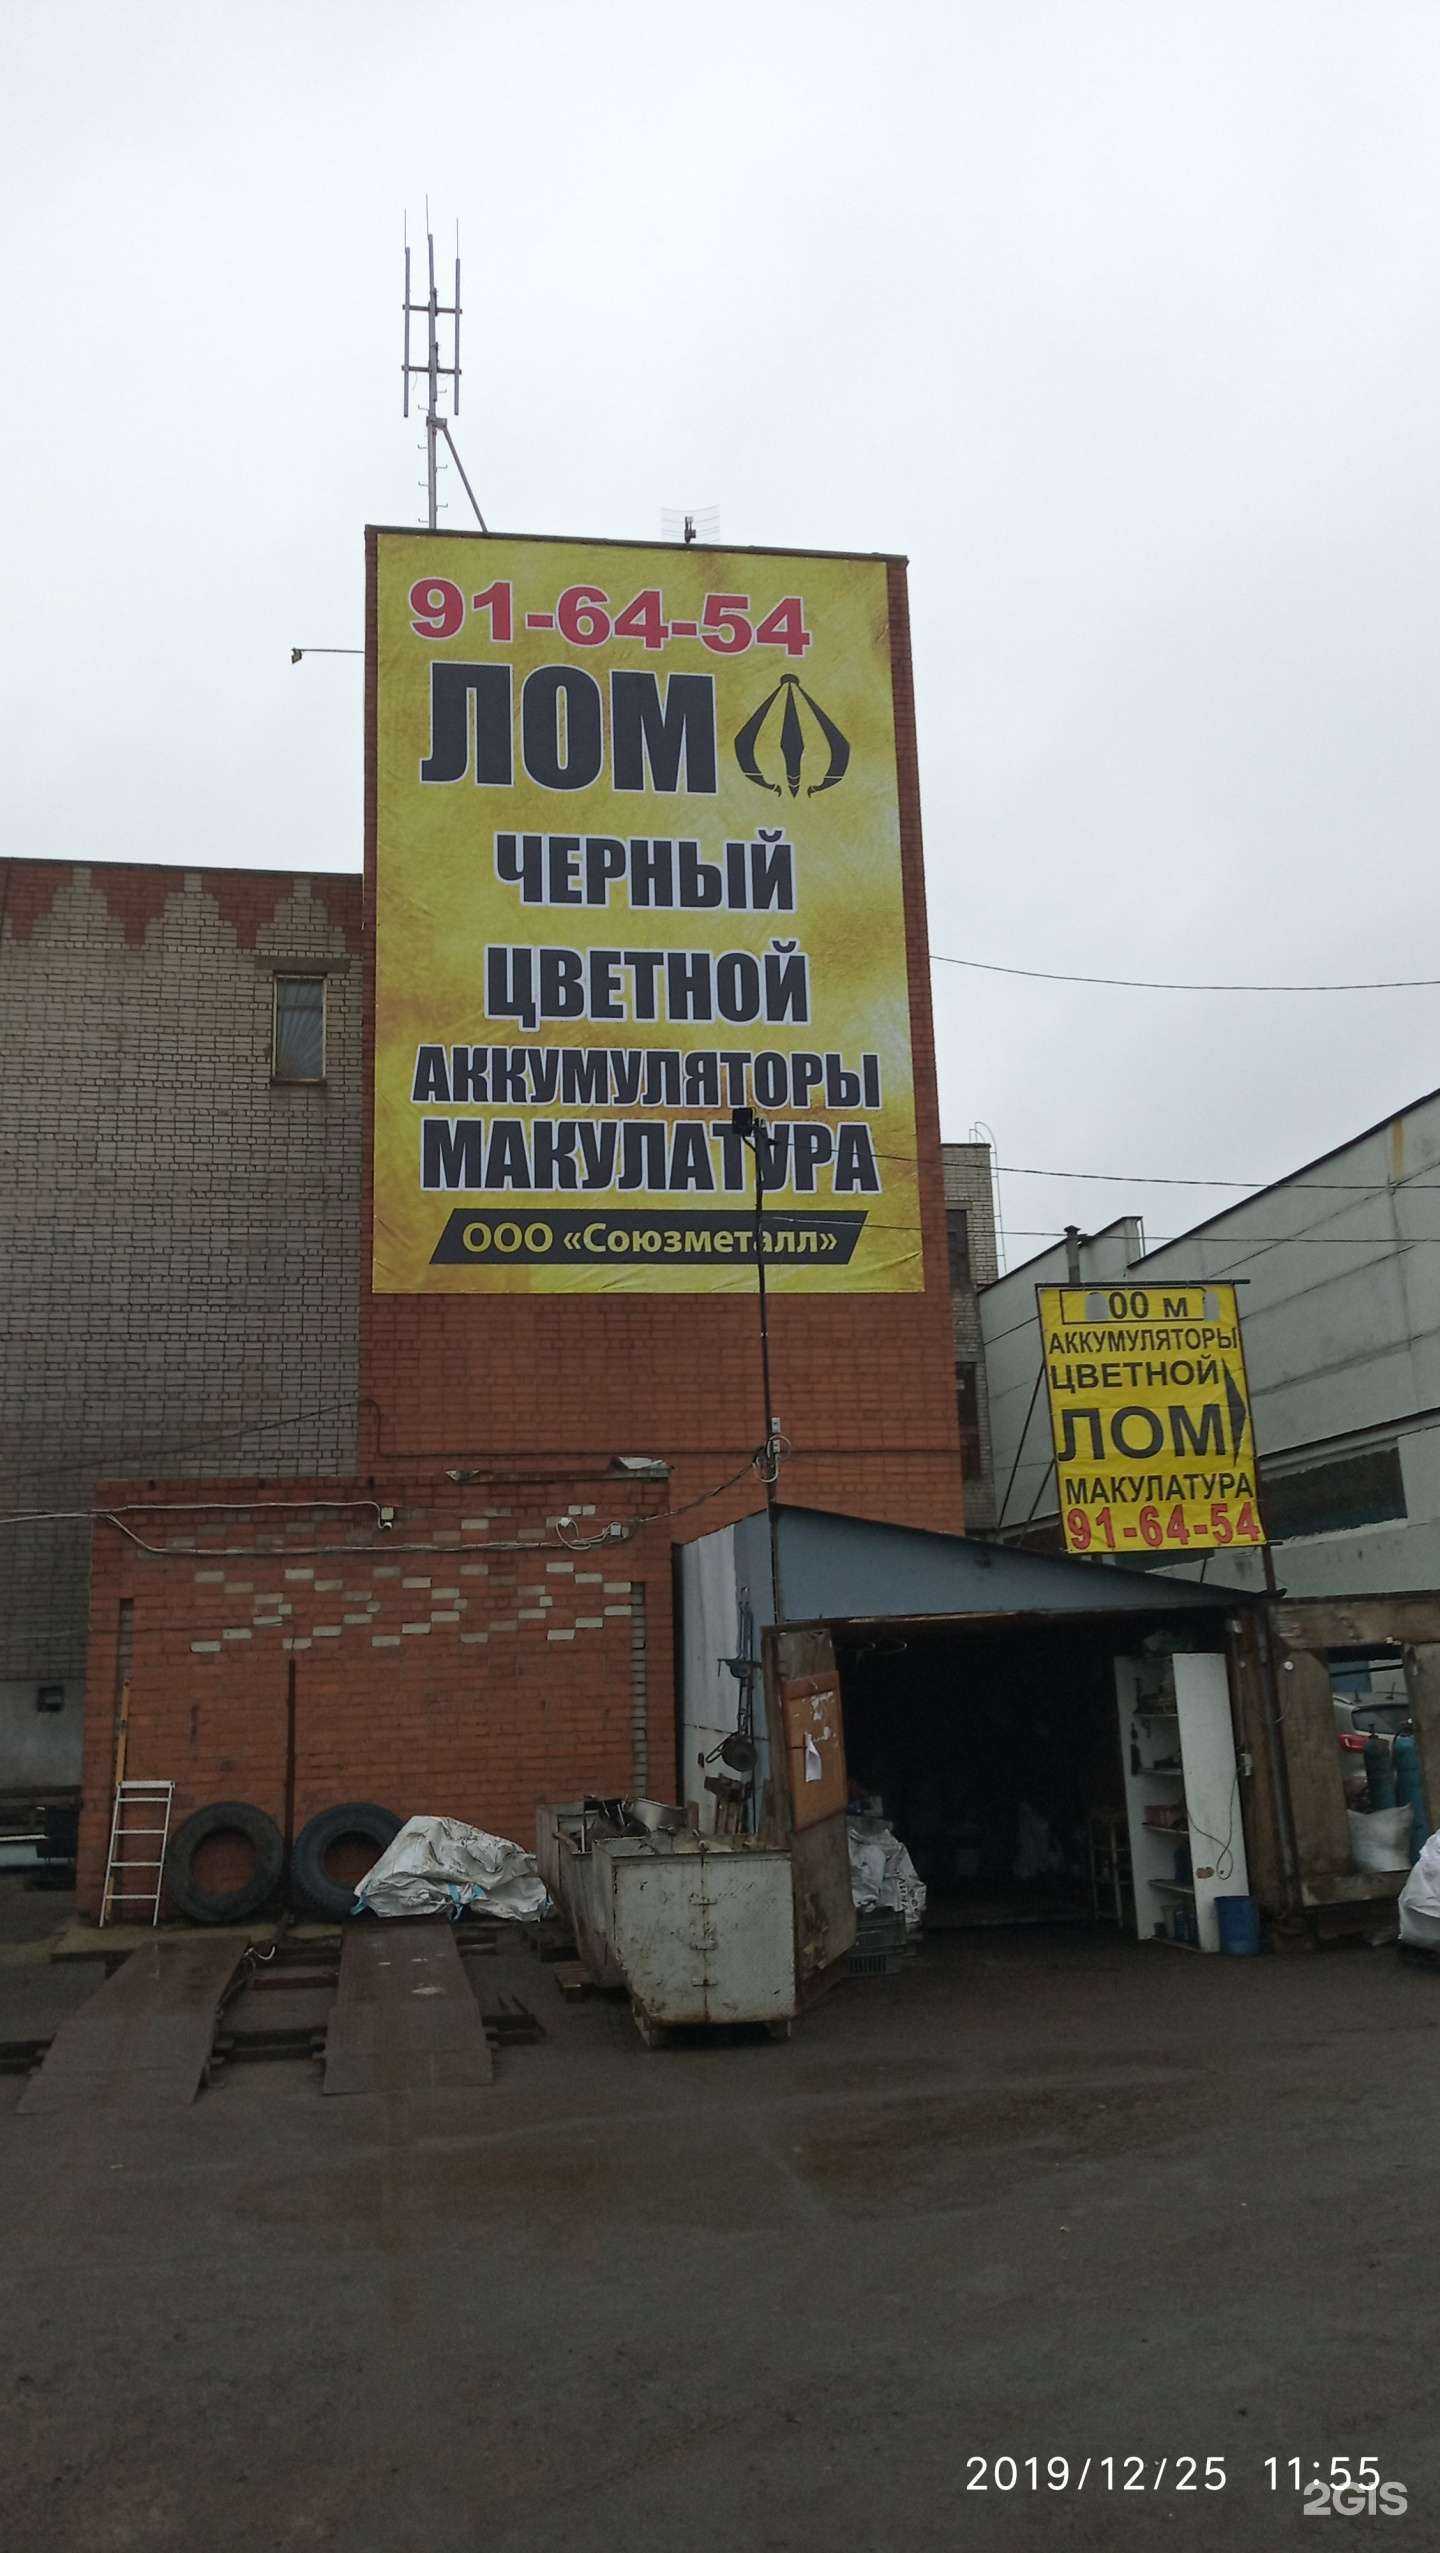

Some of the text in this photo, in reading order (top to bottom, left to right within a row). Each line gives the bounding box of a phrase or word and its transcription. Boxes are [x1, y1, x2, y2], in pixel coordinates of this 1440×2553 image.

[408, 577, 812, 656] 91-64-54
[420, 662, 718, 794] ЛОМ
[495, 827, 795, 911] ЧЕРНЫЙ
[485, 938, 810, 1031] ЦВЕТНОЙ
[412, 1045, 882, 1109] АККУМУЛЯТОРЫ
[420, 1117, 882, 1194] МАКУЛАТУРА
[462, 1222, 838, 1254] ООО «Союзметалл»
[1049, 1327, 1238, 1354] АККУМУЛЯТОРЫ
[1051, 1354, 1219, 1394] ЦВЕТНОЙ
[1058, 1403, 1226, 1462] ЛОМ
[1065, 1472, 1254, 1505] МАКУЛАТУРА
[1067, 1501, 1261, 1550] 91-64-54
